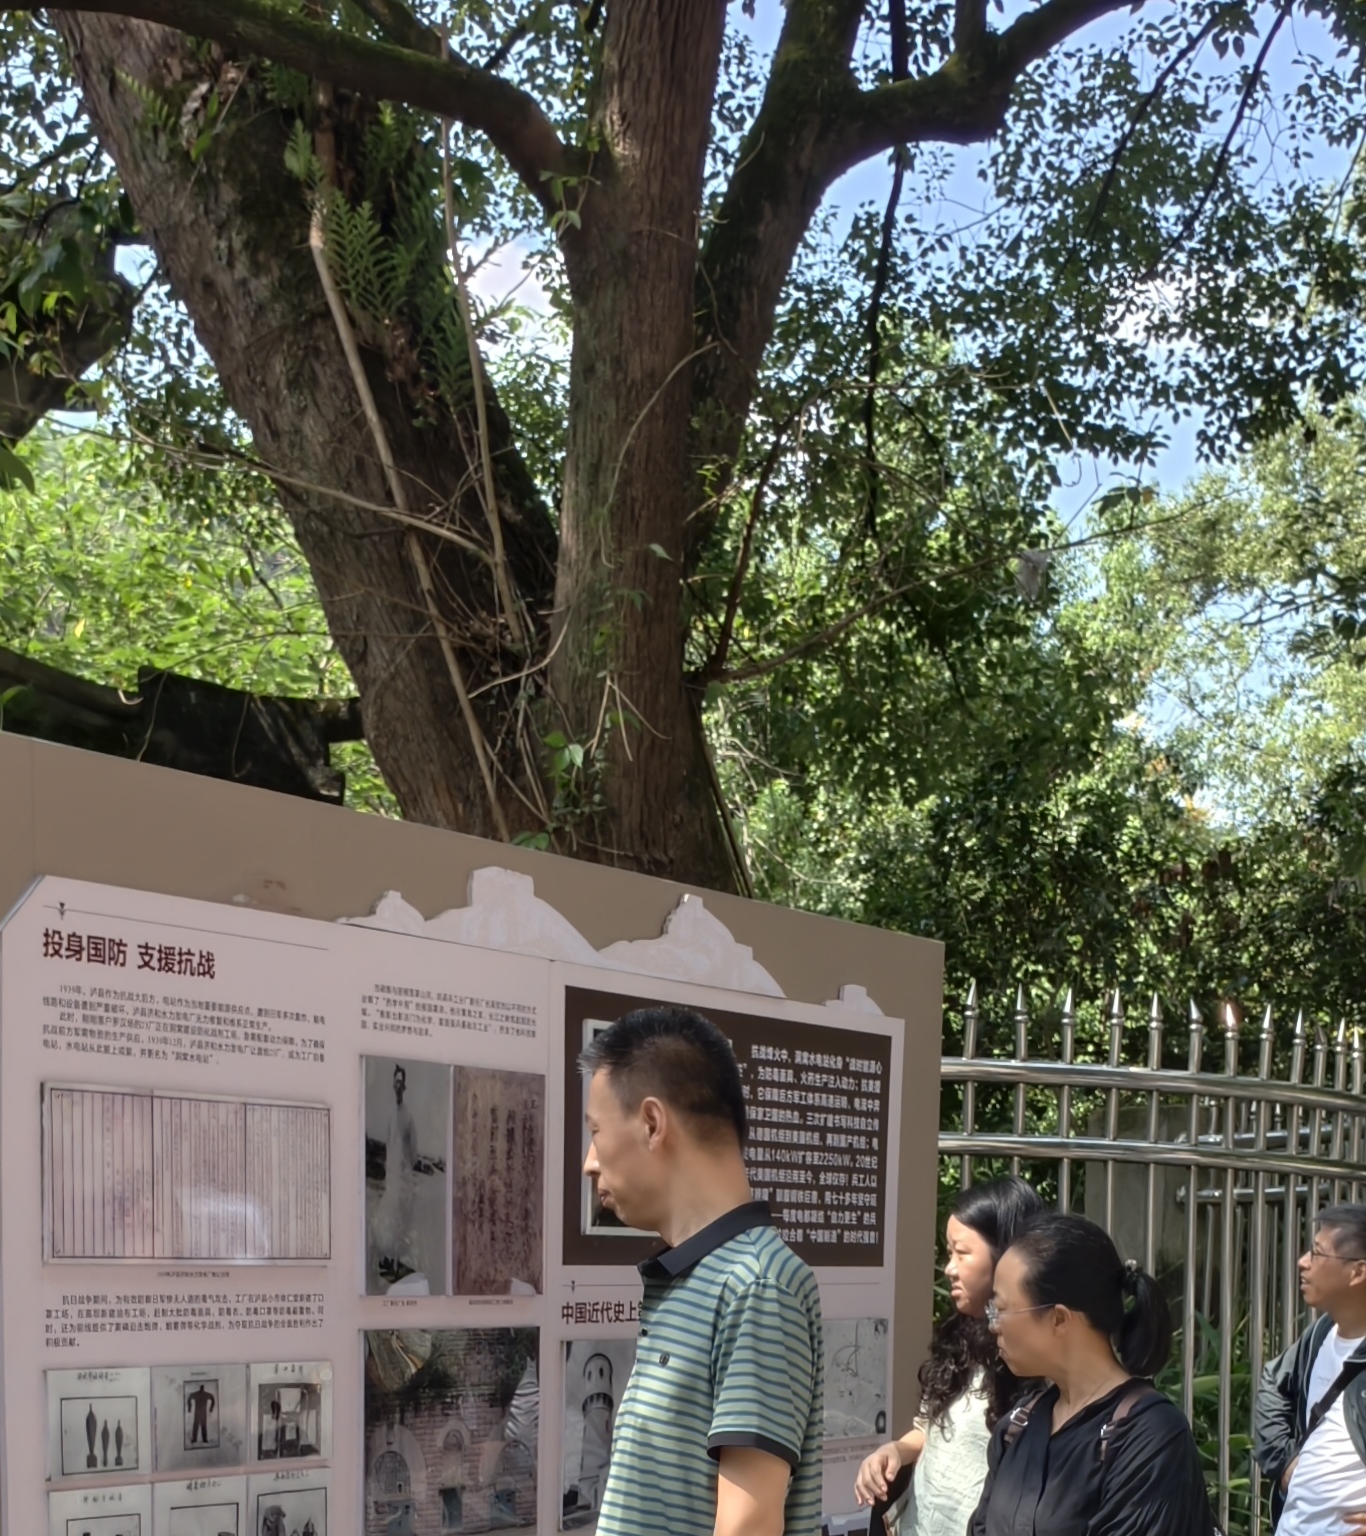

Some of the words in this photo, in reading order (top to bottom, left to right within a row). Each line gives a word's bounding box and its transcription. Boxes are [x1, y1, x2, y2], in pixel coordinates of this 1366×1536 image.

[43, 928, 128, 967] 投身国防
[137, 942, 216, 979] 支援抗战
